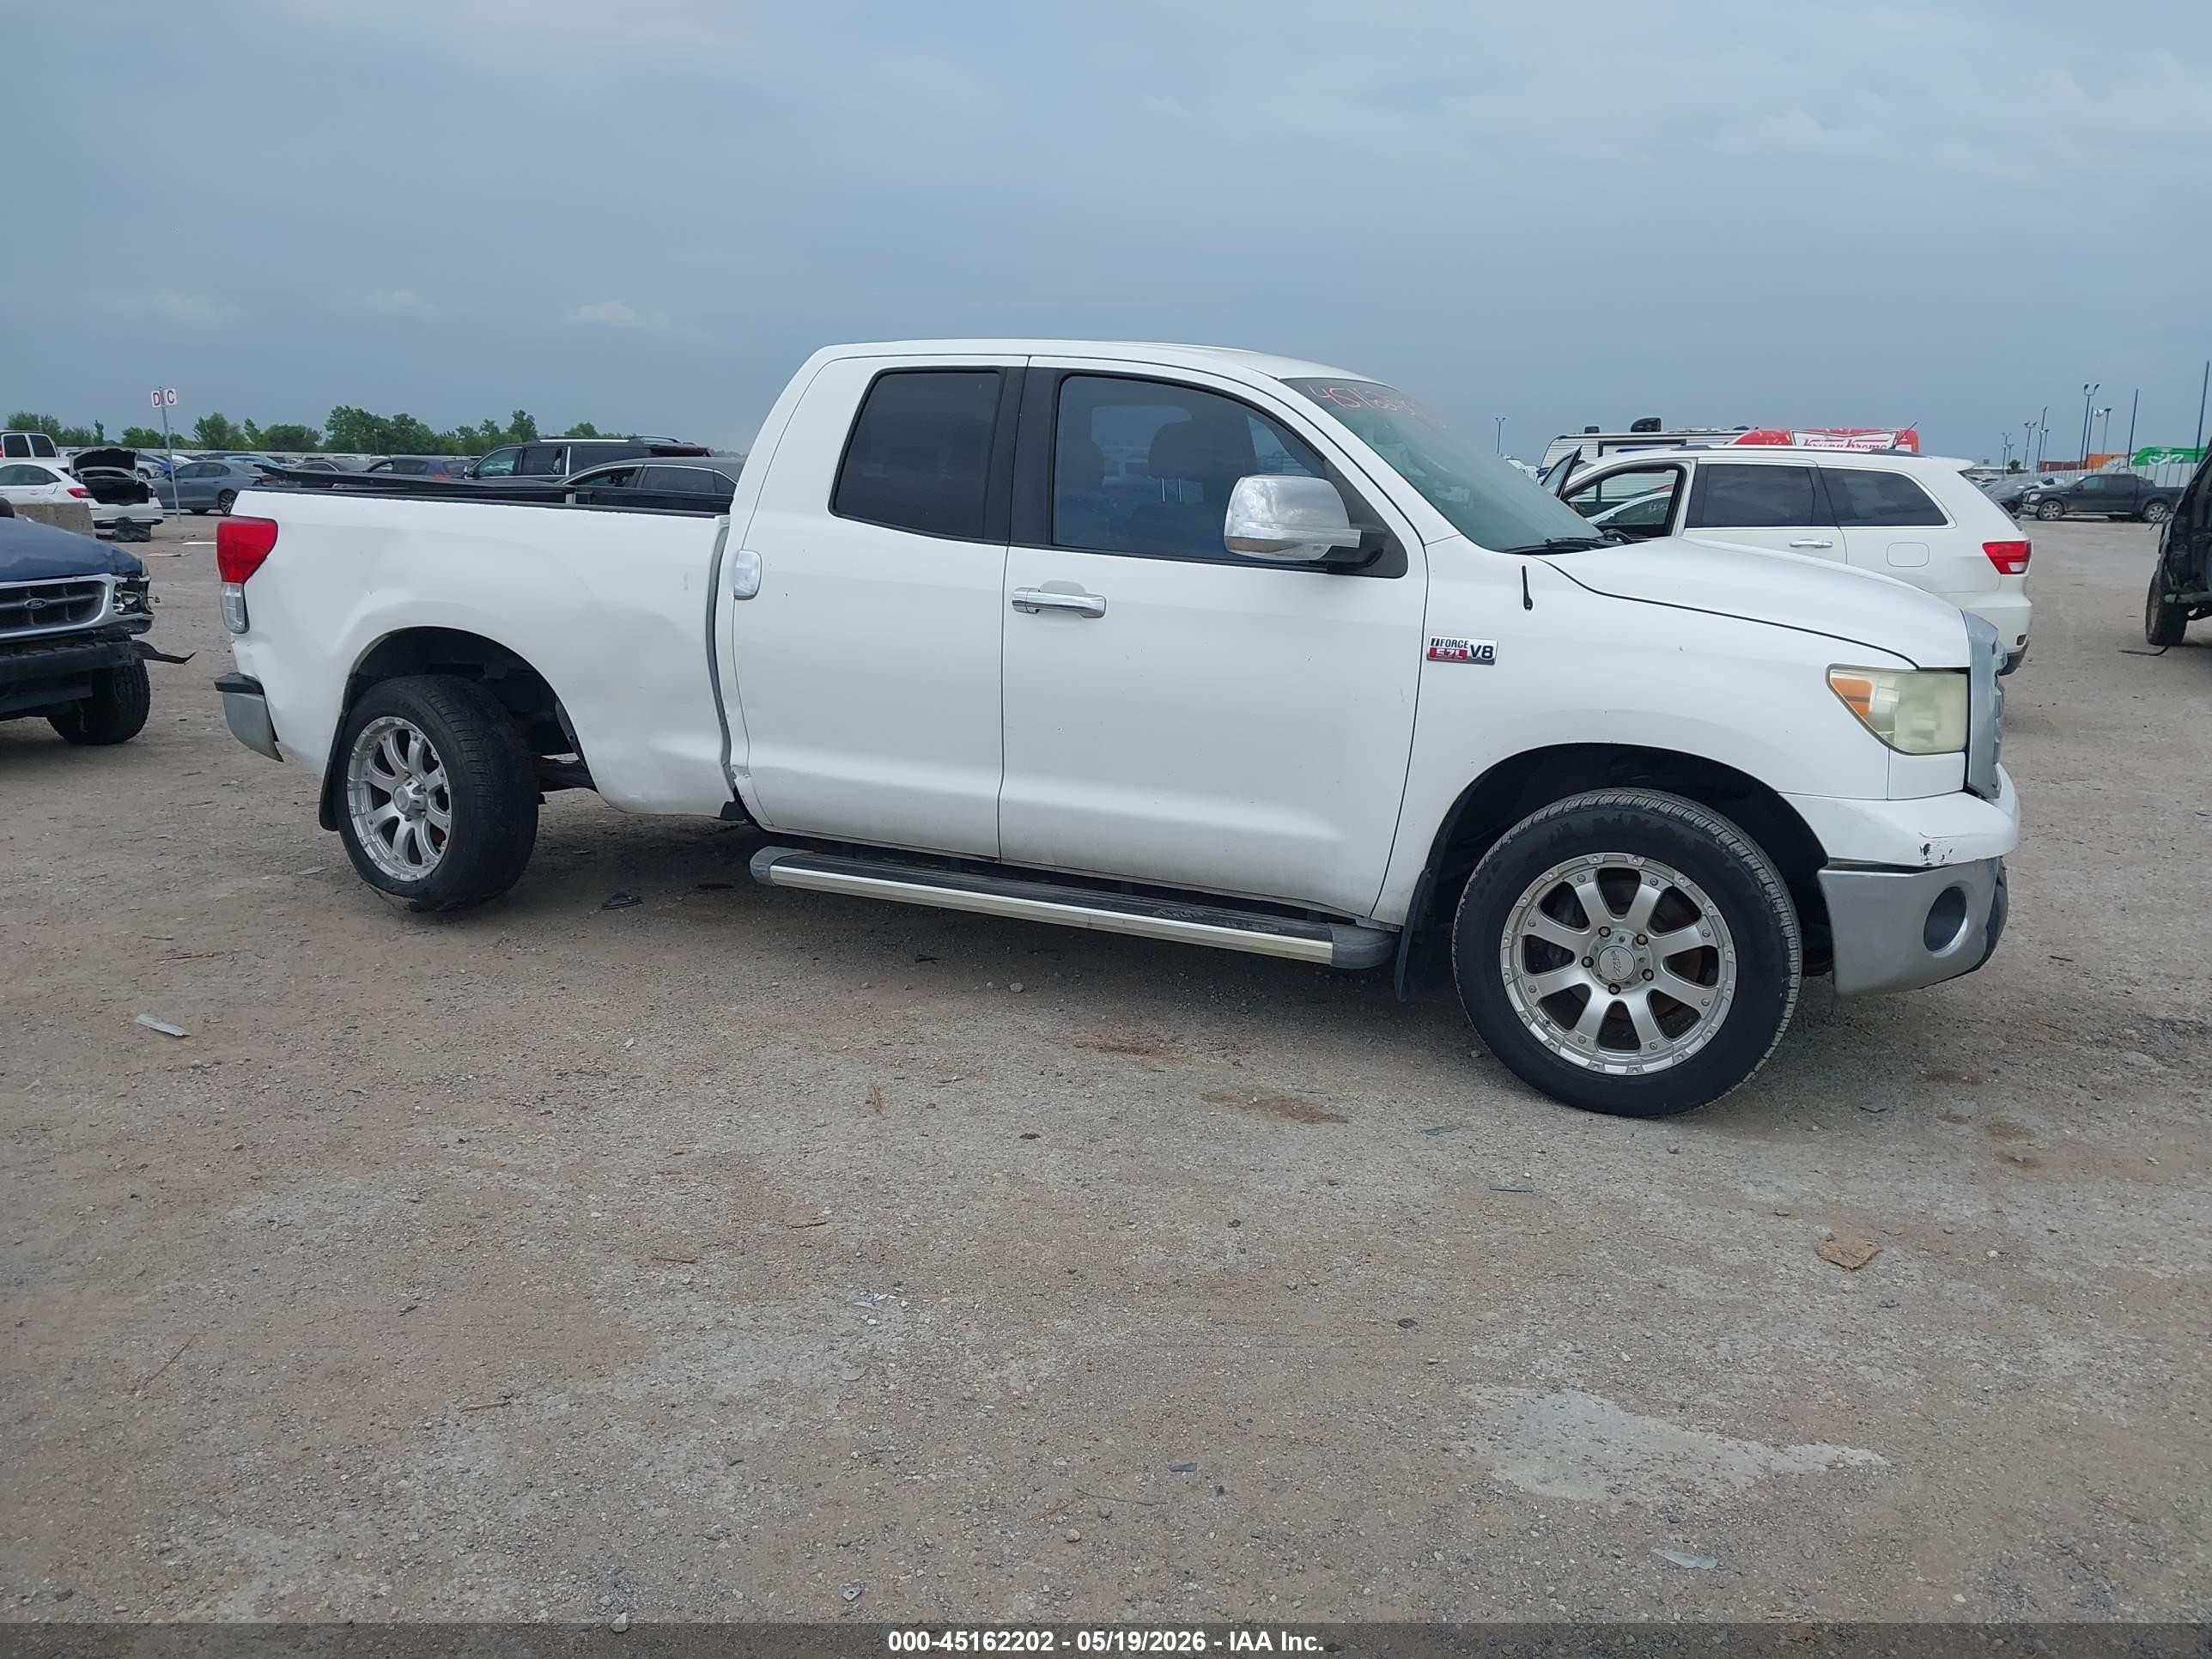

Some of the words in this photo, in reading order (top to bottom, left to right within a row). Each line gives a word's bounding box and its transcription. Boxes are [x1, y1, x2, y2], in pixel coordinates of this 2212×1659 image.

[153, 392, 161, 405] D
[167, 390, 175, 404] C
[1470, 645, 1494, 659] V8
